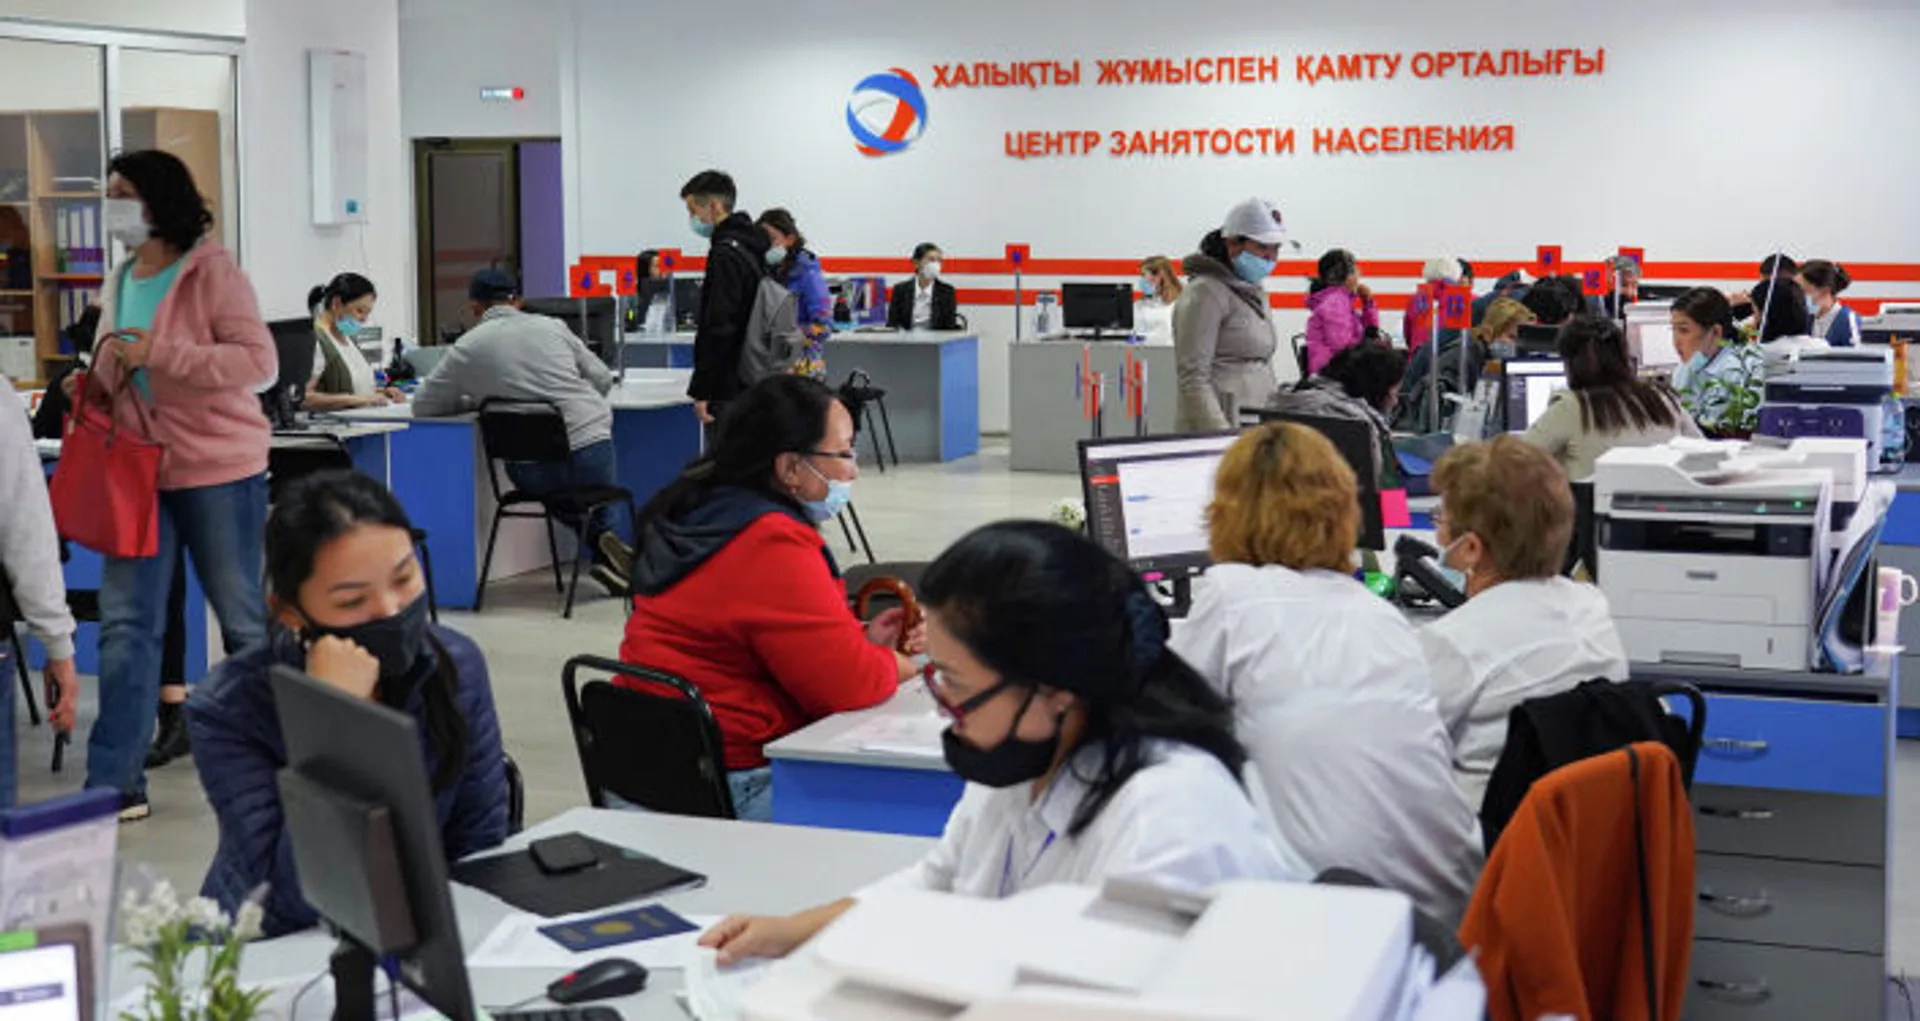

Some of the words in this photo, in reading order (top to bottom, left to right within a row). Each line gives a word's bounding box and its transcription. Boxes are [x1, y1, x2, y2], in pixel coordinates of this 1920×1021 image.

[932, 59, 1081, 89] ХАЛЫҚТЫ
[1096, 55, 1279, 85] ЖҰМЫСПЕН
[1295, 53, 1402, 86] ҚАМТУ
[1409, 47, 1605, 79] ОРТАЛЫҒЫ
[1004, 130, 1102, 160] ЦЕНТР
[1109, 127, 1296, 156] ЗАНЯТОСТИ
[1312, 124, 1516, 154] НАСЕЛЕНИЯ
[580, 271, 593, 291] 4
